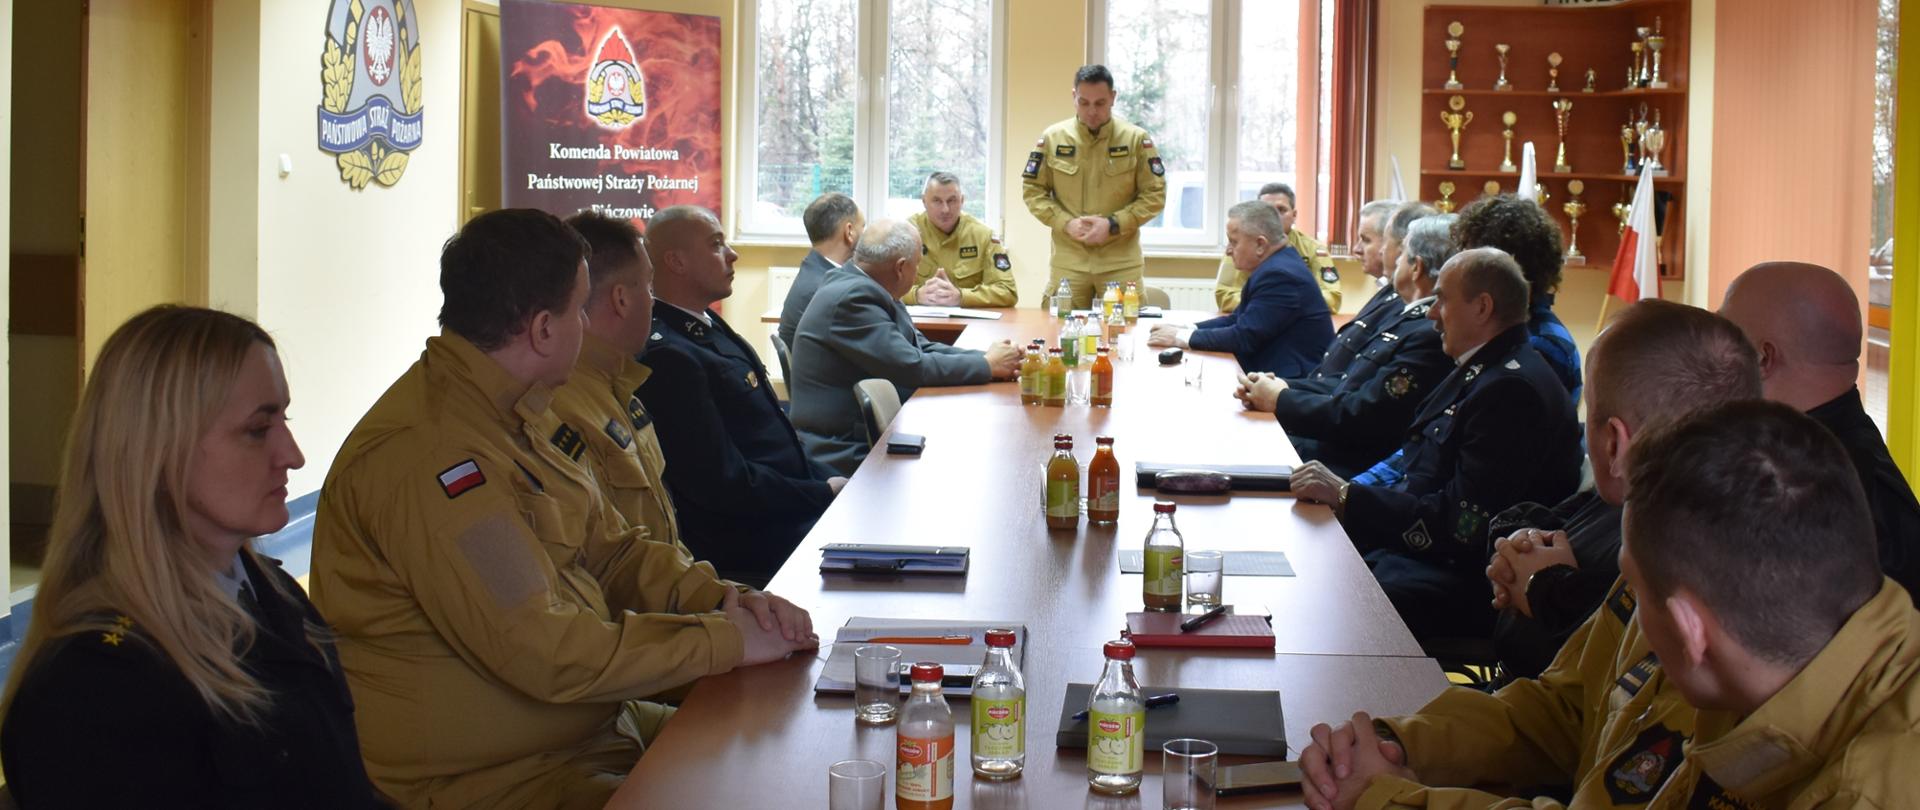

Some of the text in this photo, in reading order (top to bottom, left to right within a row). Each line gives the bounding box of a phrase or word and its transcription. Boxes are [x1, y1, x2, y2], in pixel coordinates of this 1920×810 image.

[549, 143, 679, 161] Komenda Powiatowa
[527, 173, 698, 194] Państwowej Straży Pożarnej
